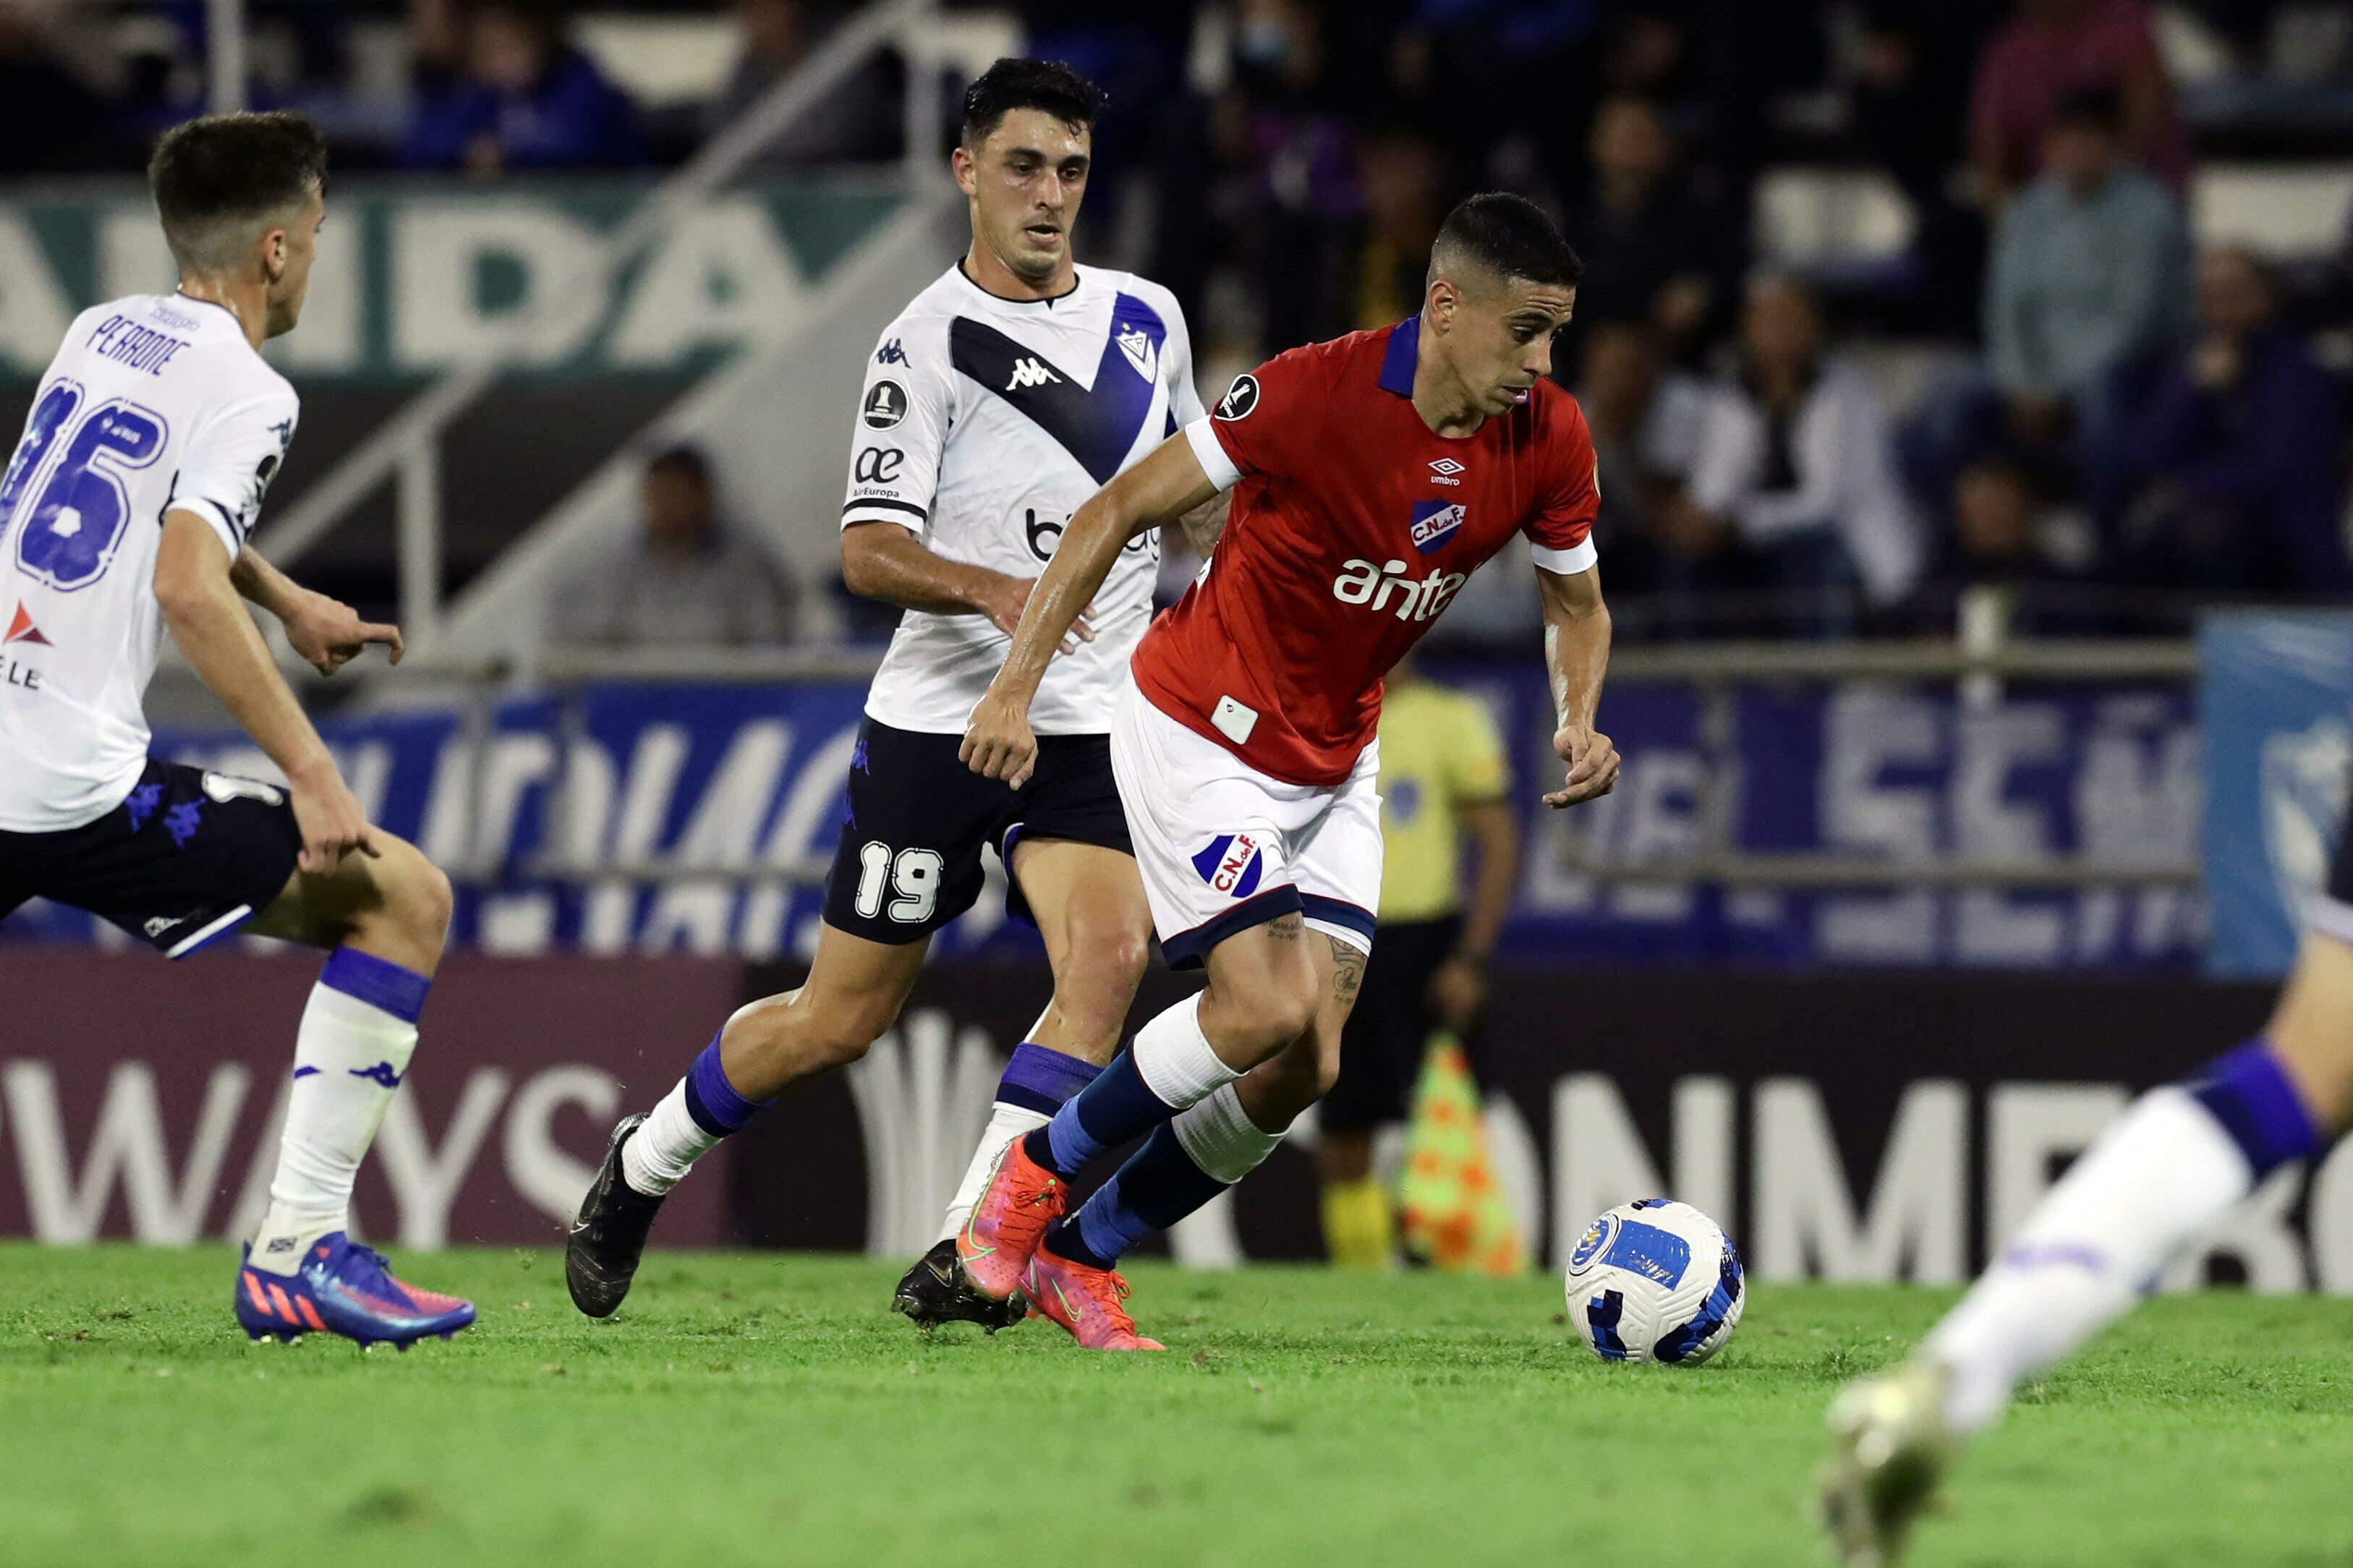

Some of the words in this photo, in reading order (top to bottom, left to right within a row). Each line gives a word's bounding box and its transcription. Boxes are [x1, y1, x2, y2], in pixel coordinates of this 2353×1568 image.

[85, 314, 192, 376] PERRONE
[0, 377, 169, 592] 16
[1431, 475, 1460, 486] umbro
[1333, 558, 1482, 621] ante
[854, 840, 944, 924] 19
